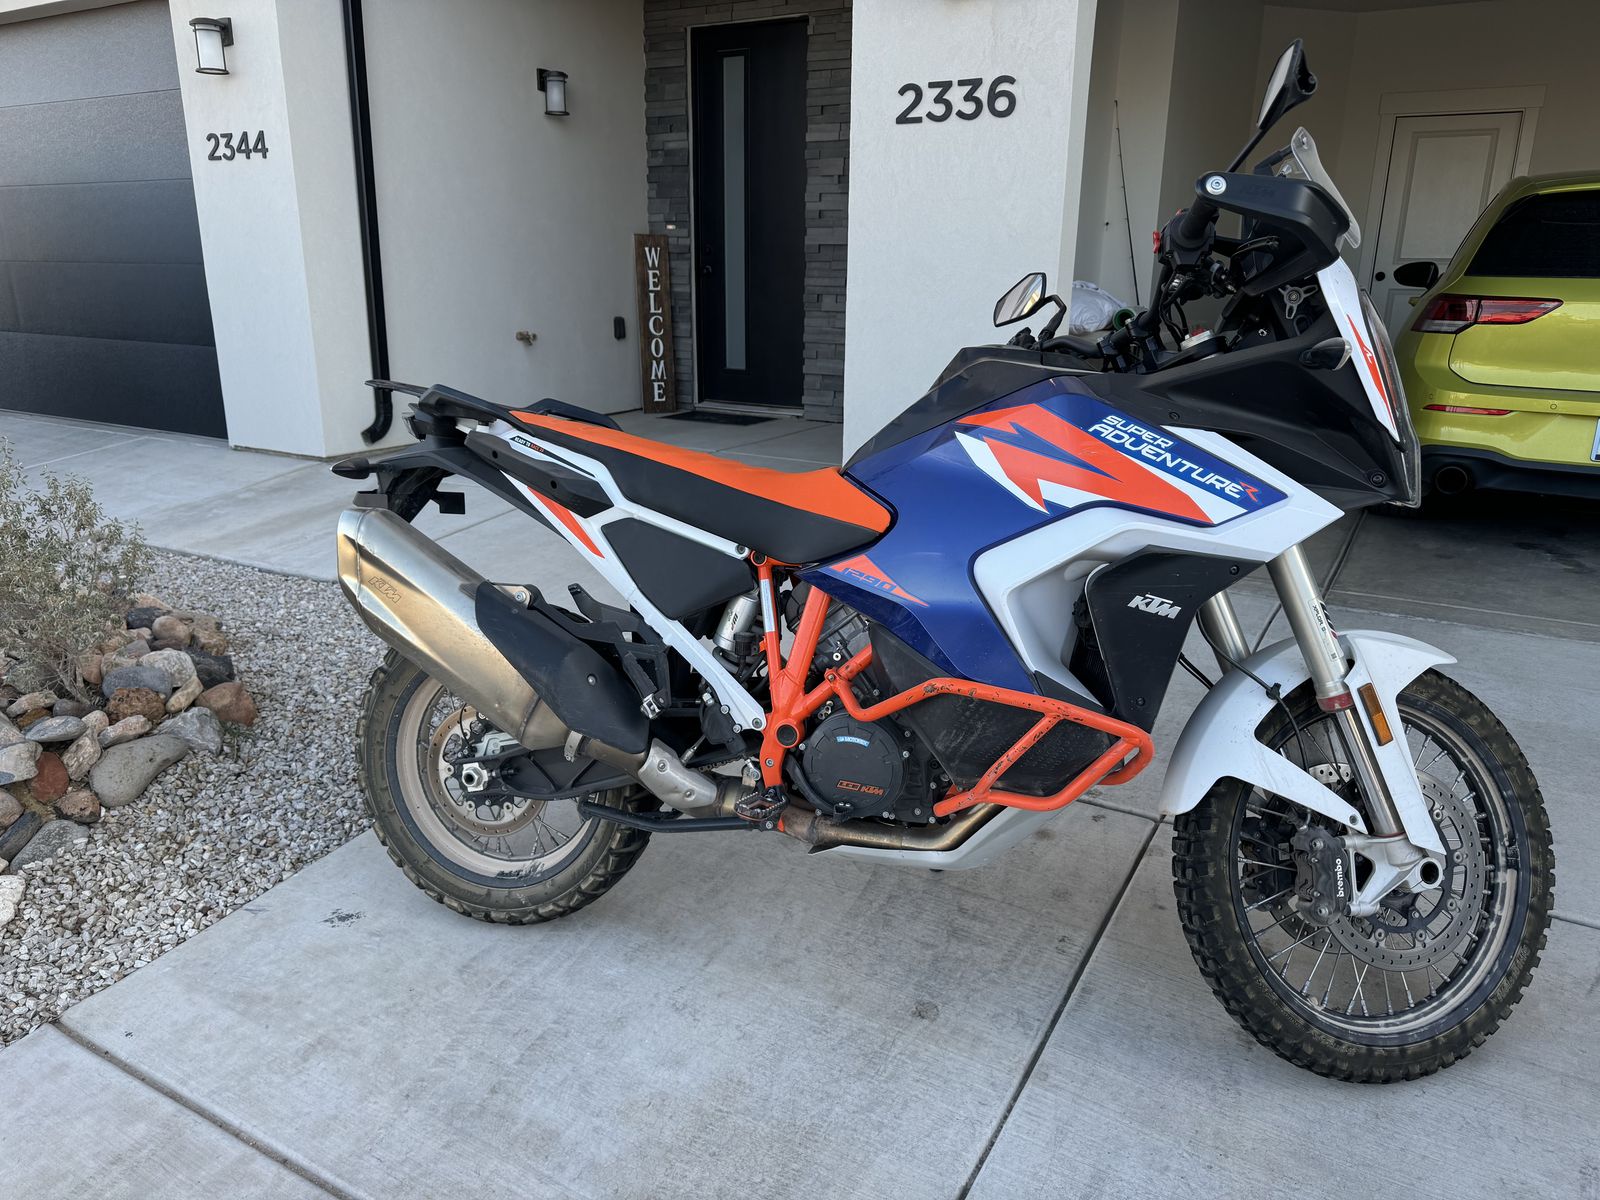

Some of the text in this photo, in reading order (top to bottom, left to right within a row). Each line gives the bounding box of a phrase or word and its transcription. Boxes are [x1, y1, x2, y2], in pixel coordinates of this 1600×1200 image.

[895, 74, 1017, 125] 2336
[206, 130, 269, 161] 2344
[644, 247, 667, 402] WELCOME
[1102, 415, 1174, 449] SUPER
[1088, 424, 1244, 499] ADVENTURE
[367, 576, 401, 603] KTM
[1127, 594, 1182, 619] KTM
[1334, 858, 1345, 898] brembo
